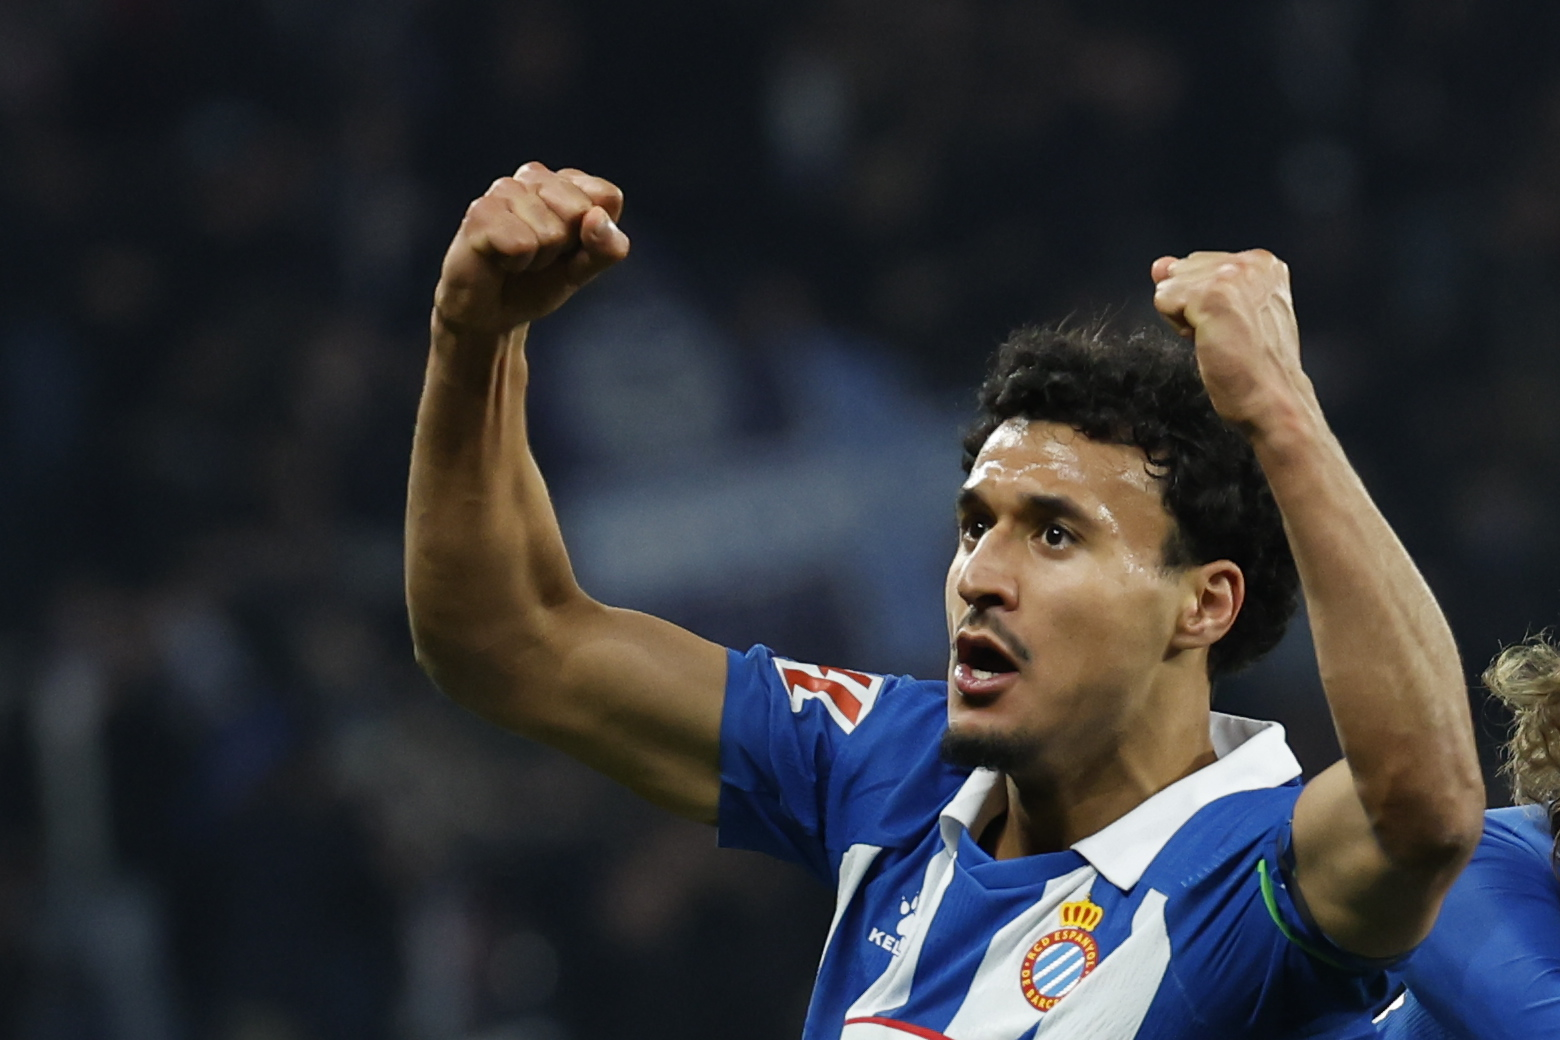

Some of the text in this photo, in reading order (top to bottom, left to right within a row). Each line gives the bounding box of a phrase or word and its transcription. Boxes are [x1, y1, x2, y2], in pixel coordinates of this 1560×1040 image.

[868, 927, 901, 957] KEL
[1027, 930, 1096, 968] RCD ESPANYOL
[1021, 969, 1031, 987] DE
